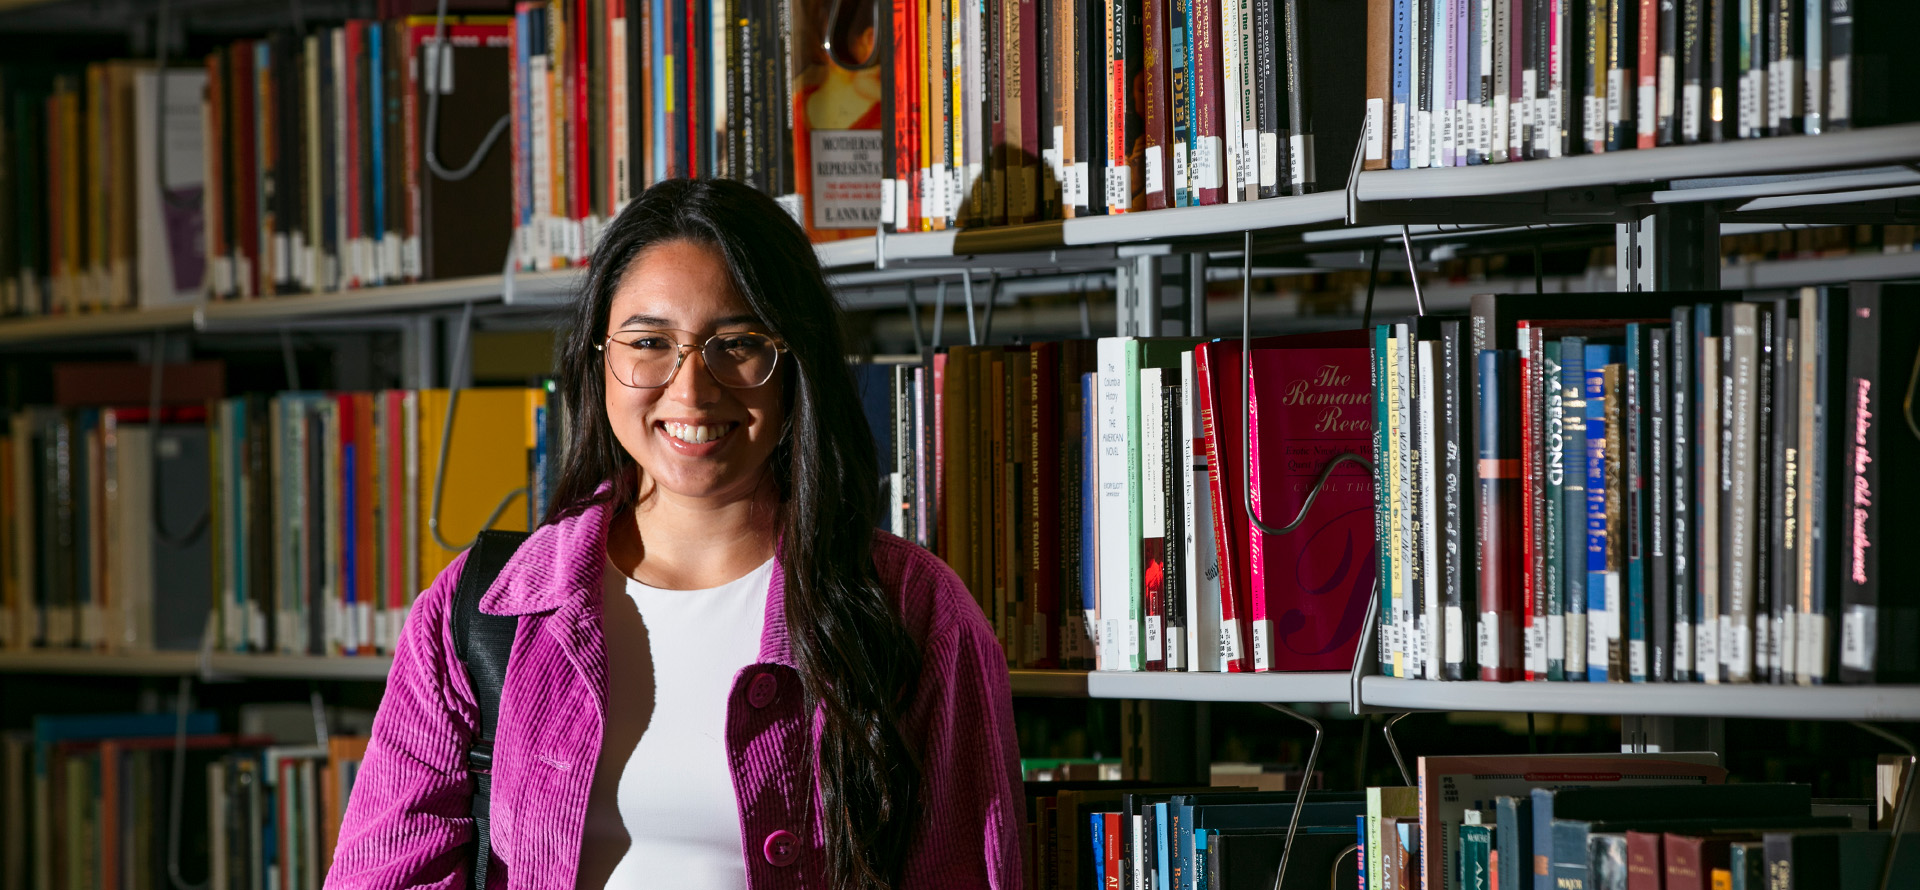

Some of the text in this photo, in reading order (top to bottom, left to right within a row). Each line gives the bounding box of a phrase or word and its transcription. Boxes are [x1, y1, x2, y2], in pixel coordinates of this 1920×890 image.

[1146, 24, 1152, 44] OF
[1224, 30, 1232, 80] SLAVERY
[1013, 39, 1021, 98] WOMEN
[1117, 64, 1122, 73] In
[1145, 47, 1159, 124] RACHEL
[1197, 41, 1205, 97] WRITERS
[1242, 12, 1252, 122] the American Canon
[1174, 71, 1184, 122] DLB
[823, 136, 881, 150] MOTHERHO
[817, 162, 881, 177] REPRESENTA
[1104, 378, 1120, 387] Columbia
[1282, 379, 1372, 406] Romanc
[1314, 364, 1352, 387] The
[1446, 372, 1452, 384] A.
[1739, 356, 1748, 385] THE
[1106, 392, 1118, 403] History
[1314, 406, 1374, 433] Revo
[1370, 347, 1378, 387] Levander
[1374, 470, 1381, 480] of
[1722, 376, 1732, 426] Middle
[1103, 433, 1124, 443] AMERICAN
[1106, 446, 1119, 456] NOVEL
[1399, 432, 1408, 484] WOMEN
[1446, 440, 1458, 468] The
[1550, 394, 1562, 485] SECOND
[1390, 347, 1401, 581] Middlebrow Moderns
[1533, 350, 1544, 617] Conversations with American Novelists
[1675, 391, 1685, 575] Passion and Craft
[1852, 378, 1872, 585] Fetching the Old Southwest
[1384, 496, 1390, 509] OF
[1410, 449, 1420, 581] Sharing Secrets
[1445, 472, 1457, 516] Plight
[1784, 448, 1796, 550] In Her Own Voice
[1250, 482, 1261, 576] Relution
[1401, 490, 1409, 563] TALKING
[1445, 520, 1457, 536] of
[1356, 842, 1364, 870] The
